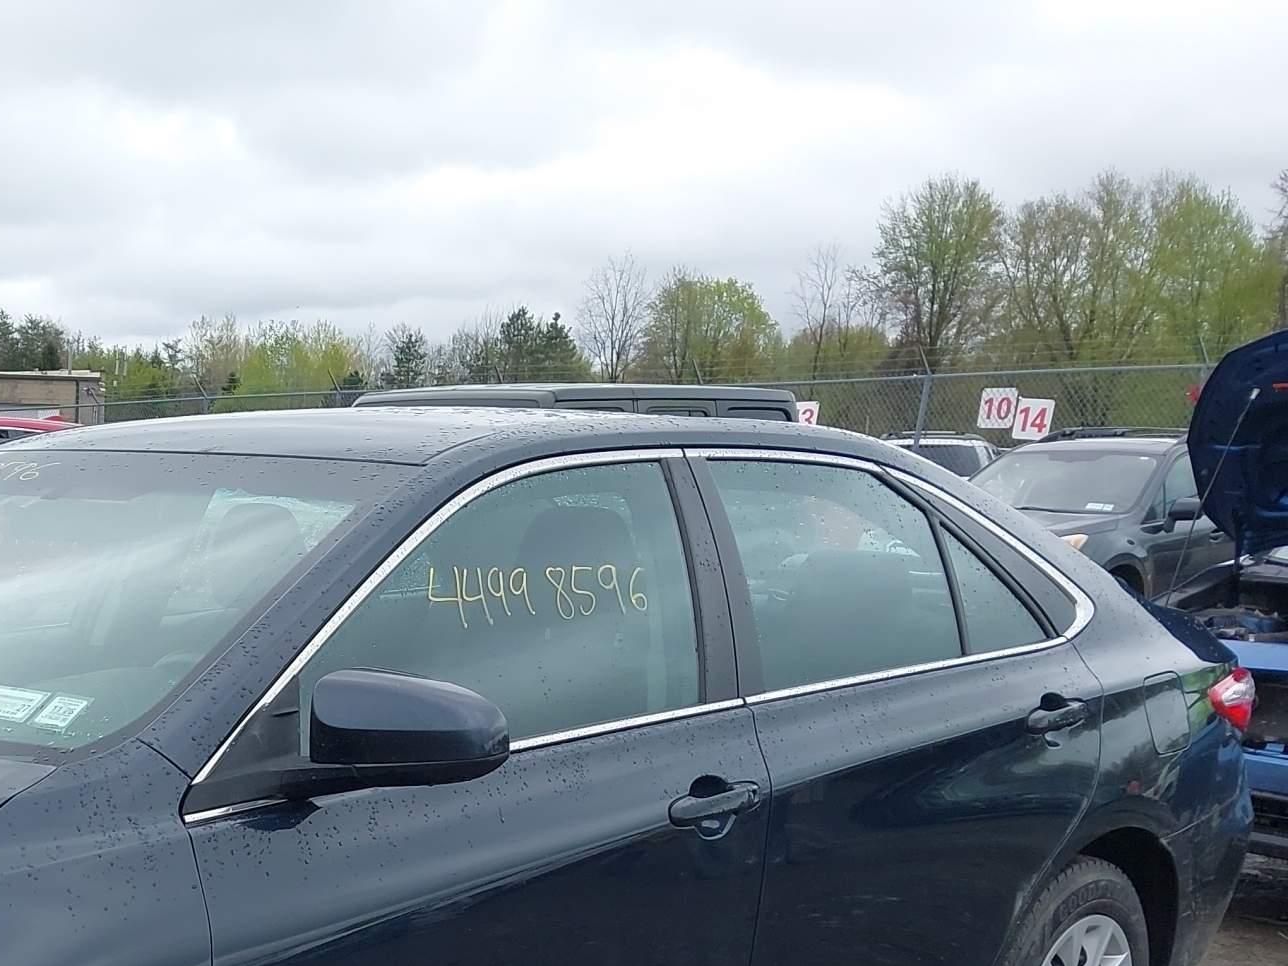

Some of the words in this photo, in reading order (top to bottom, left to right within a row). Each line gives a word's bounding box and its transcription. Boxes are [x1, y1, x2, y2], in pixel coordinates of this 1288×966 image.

[984, 396, 1012, 421] 10
[1019, 406, 1047, 433] 14
[428, 566, 537, 629] 4499
[545, 564, 648, 620] 8596
